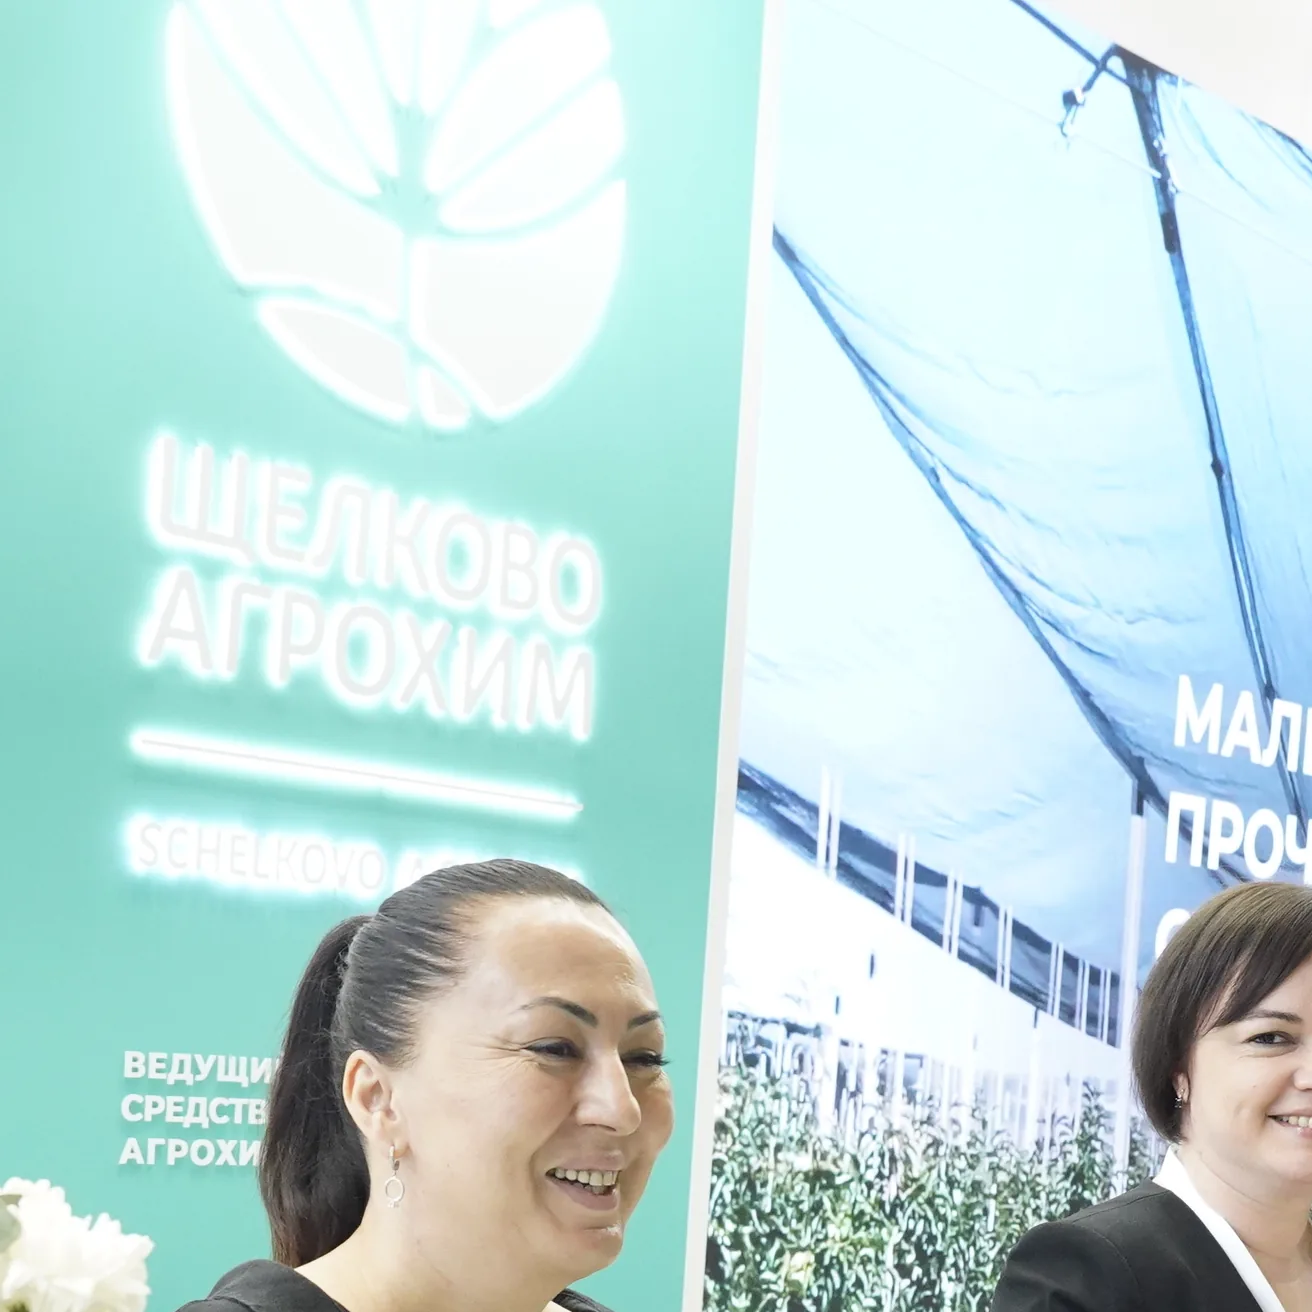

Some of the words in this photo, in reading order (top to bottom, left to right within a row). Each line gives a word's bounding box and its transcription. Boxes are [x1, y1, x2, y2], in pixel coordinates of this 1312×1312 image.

[151, 434, 603, 628] ЩЕЛКОВО
[143, 568, 593, 741] АГРОХИМ
[137, 818, 386, 893] SCHELKOVO
[123, 1051, 281, 1087] ВЕДУЩИ
[118, 1137, 261, 1167] АГРОХИ
